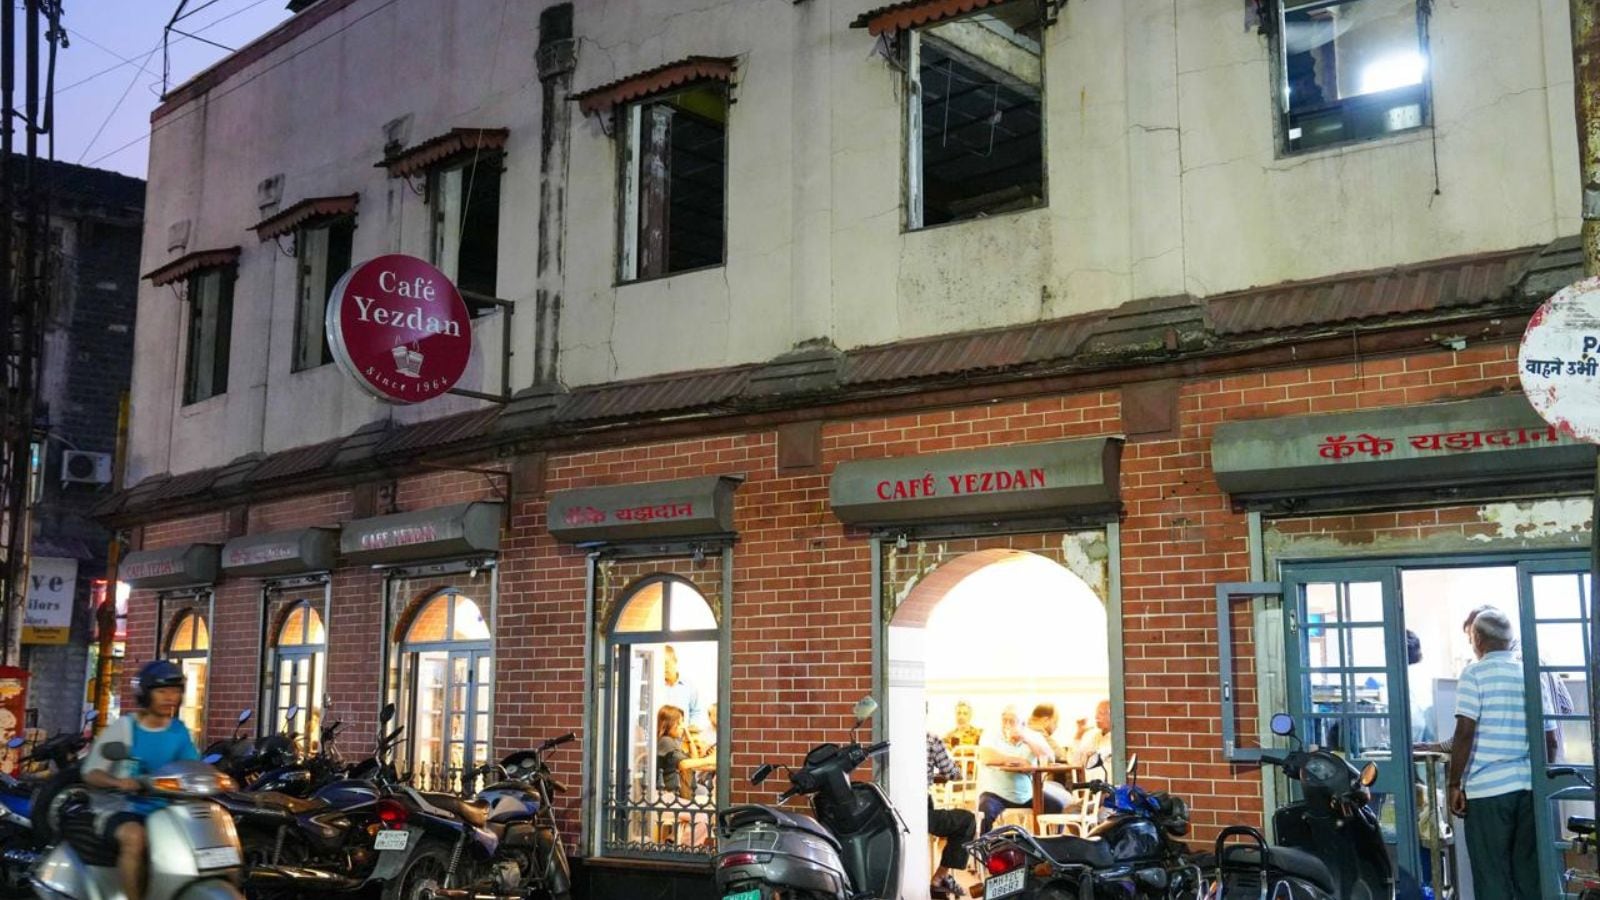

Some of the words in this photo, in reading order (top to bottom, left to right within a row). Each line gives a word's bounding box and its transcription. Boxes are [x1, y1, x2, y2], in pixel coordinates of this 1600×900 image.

[379, 271, 435, 301] Café
[352, 295, 461, 337] Yezdan
[1583, 336, 1600, 353] P
[366, 366, 406, 391] Since
[416, 376, 448, 392] 1964
[876, 473, 936, 500] CAFÉ
[948, 468, 1046, 494] YEZDAN
[31, 575, 64, 592] ve
